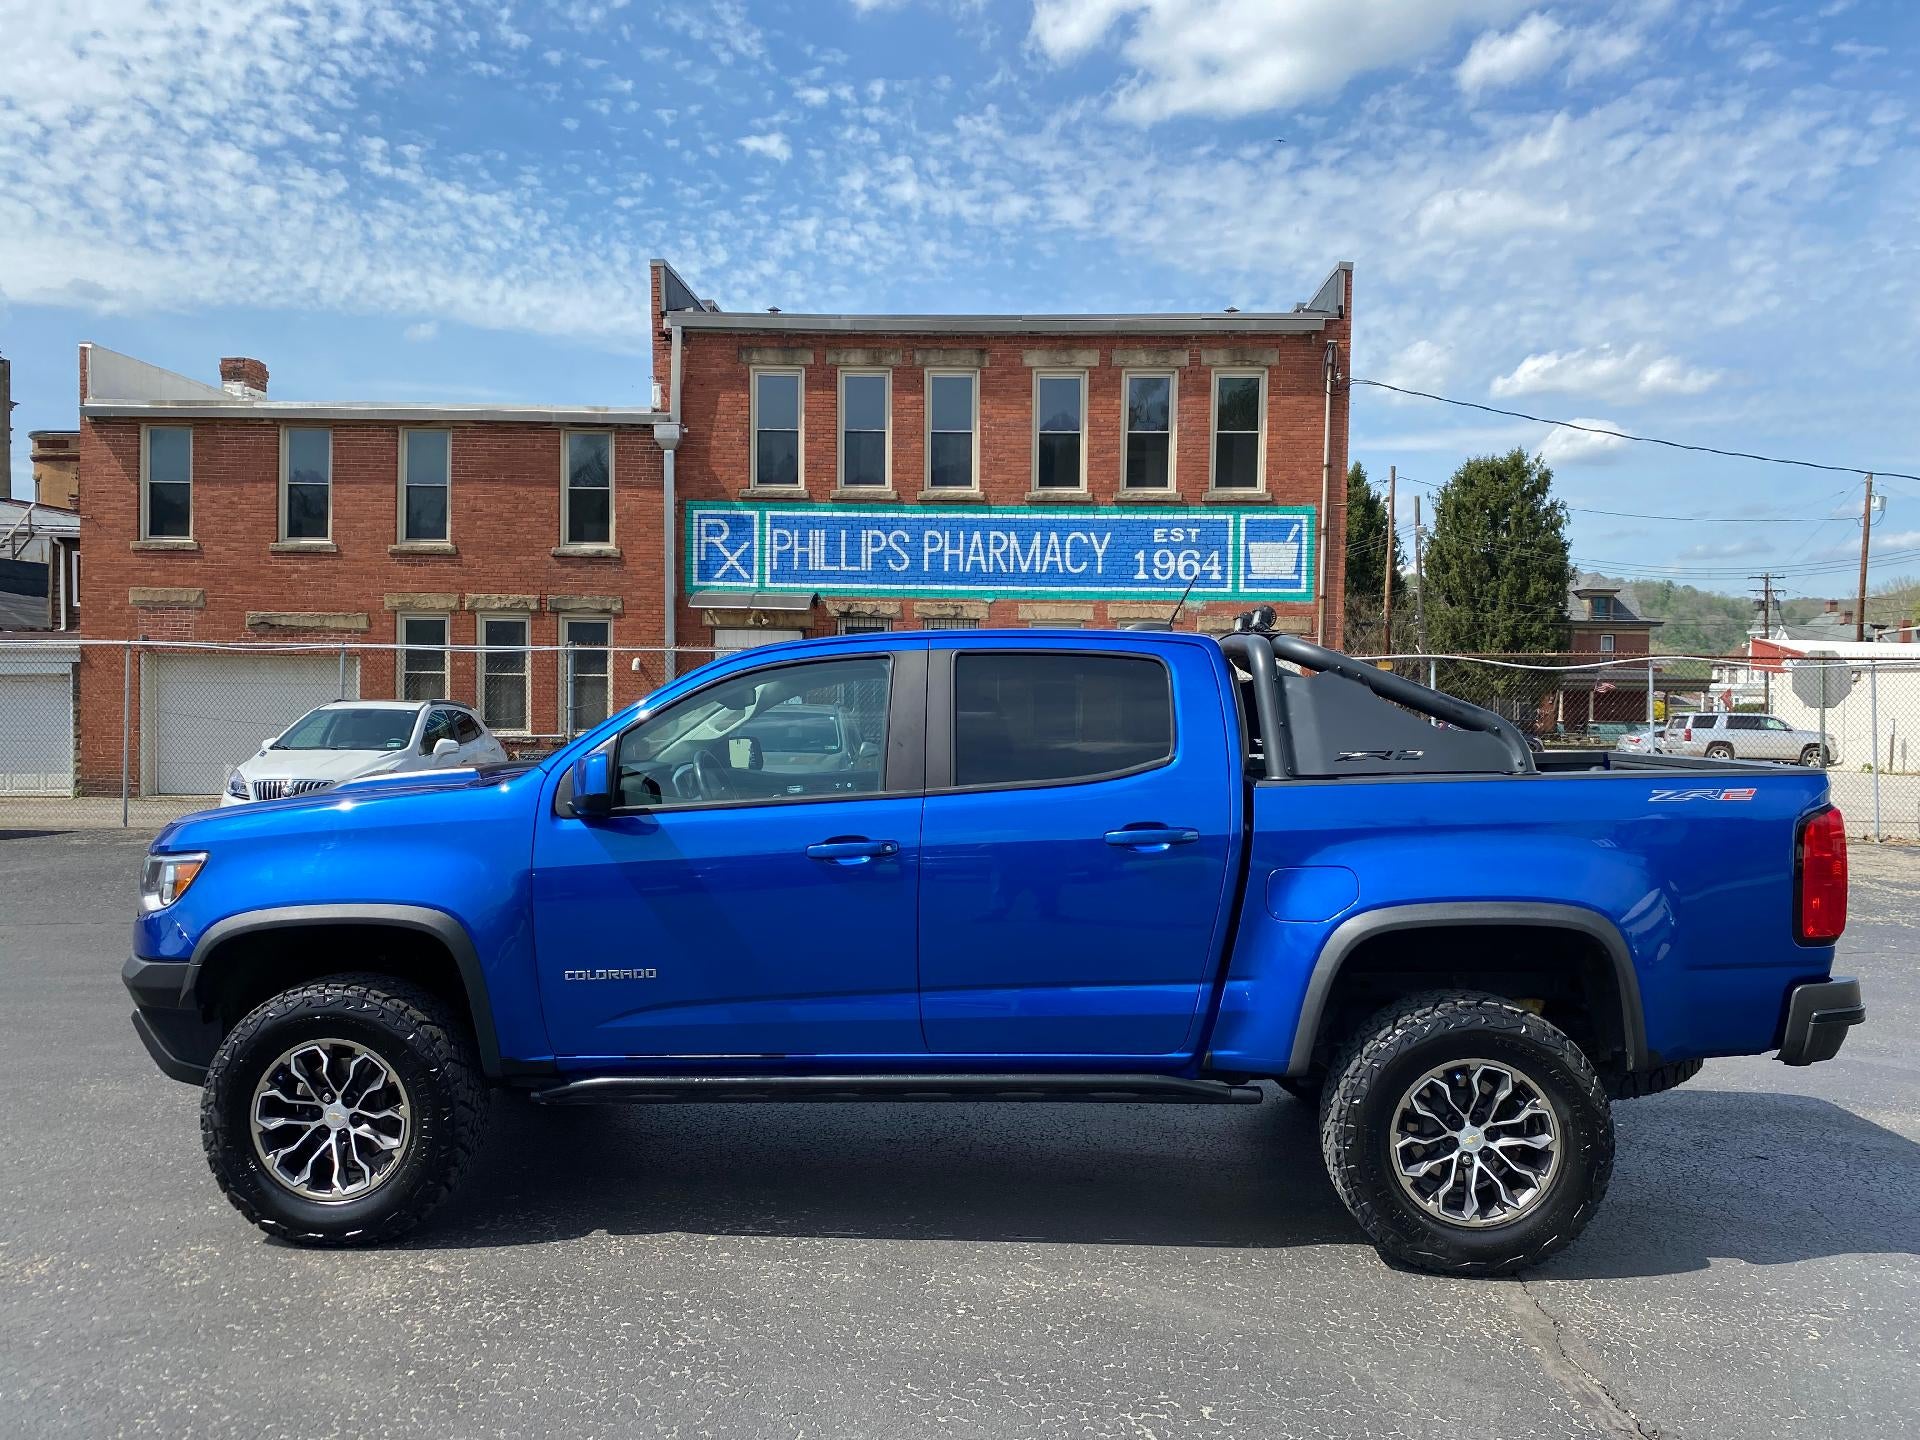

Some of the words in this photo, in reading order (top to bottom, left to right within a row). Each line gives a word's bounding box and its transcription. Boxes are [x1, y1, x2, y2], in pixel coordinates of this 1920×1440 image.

[1153, 527, 1201, 543] EST
[772, 529, 910, 571] PHILLIPS
[922, 530, 1112, 574] PHARMACY
[1133, 548, 1222, 581] 1964
[1647, 787, 1758, 802] ZR2
[564, 968, 657, 981] COLORADO
